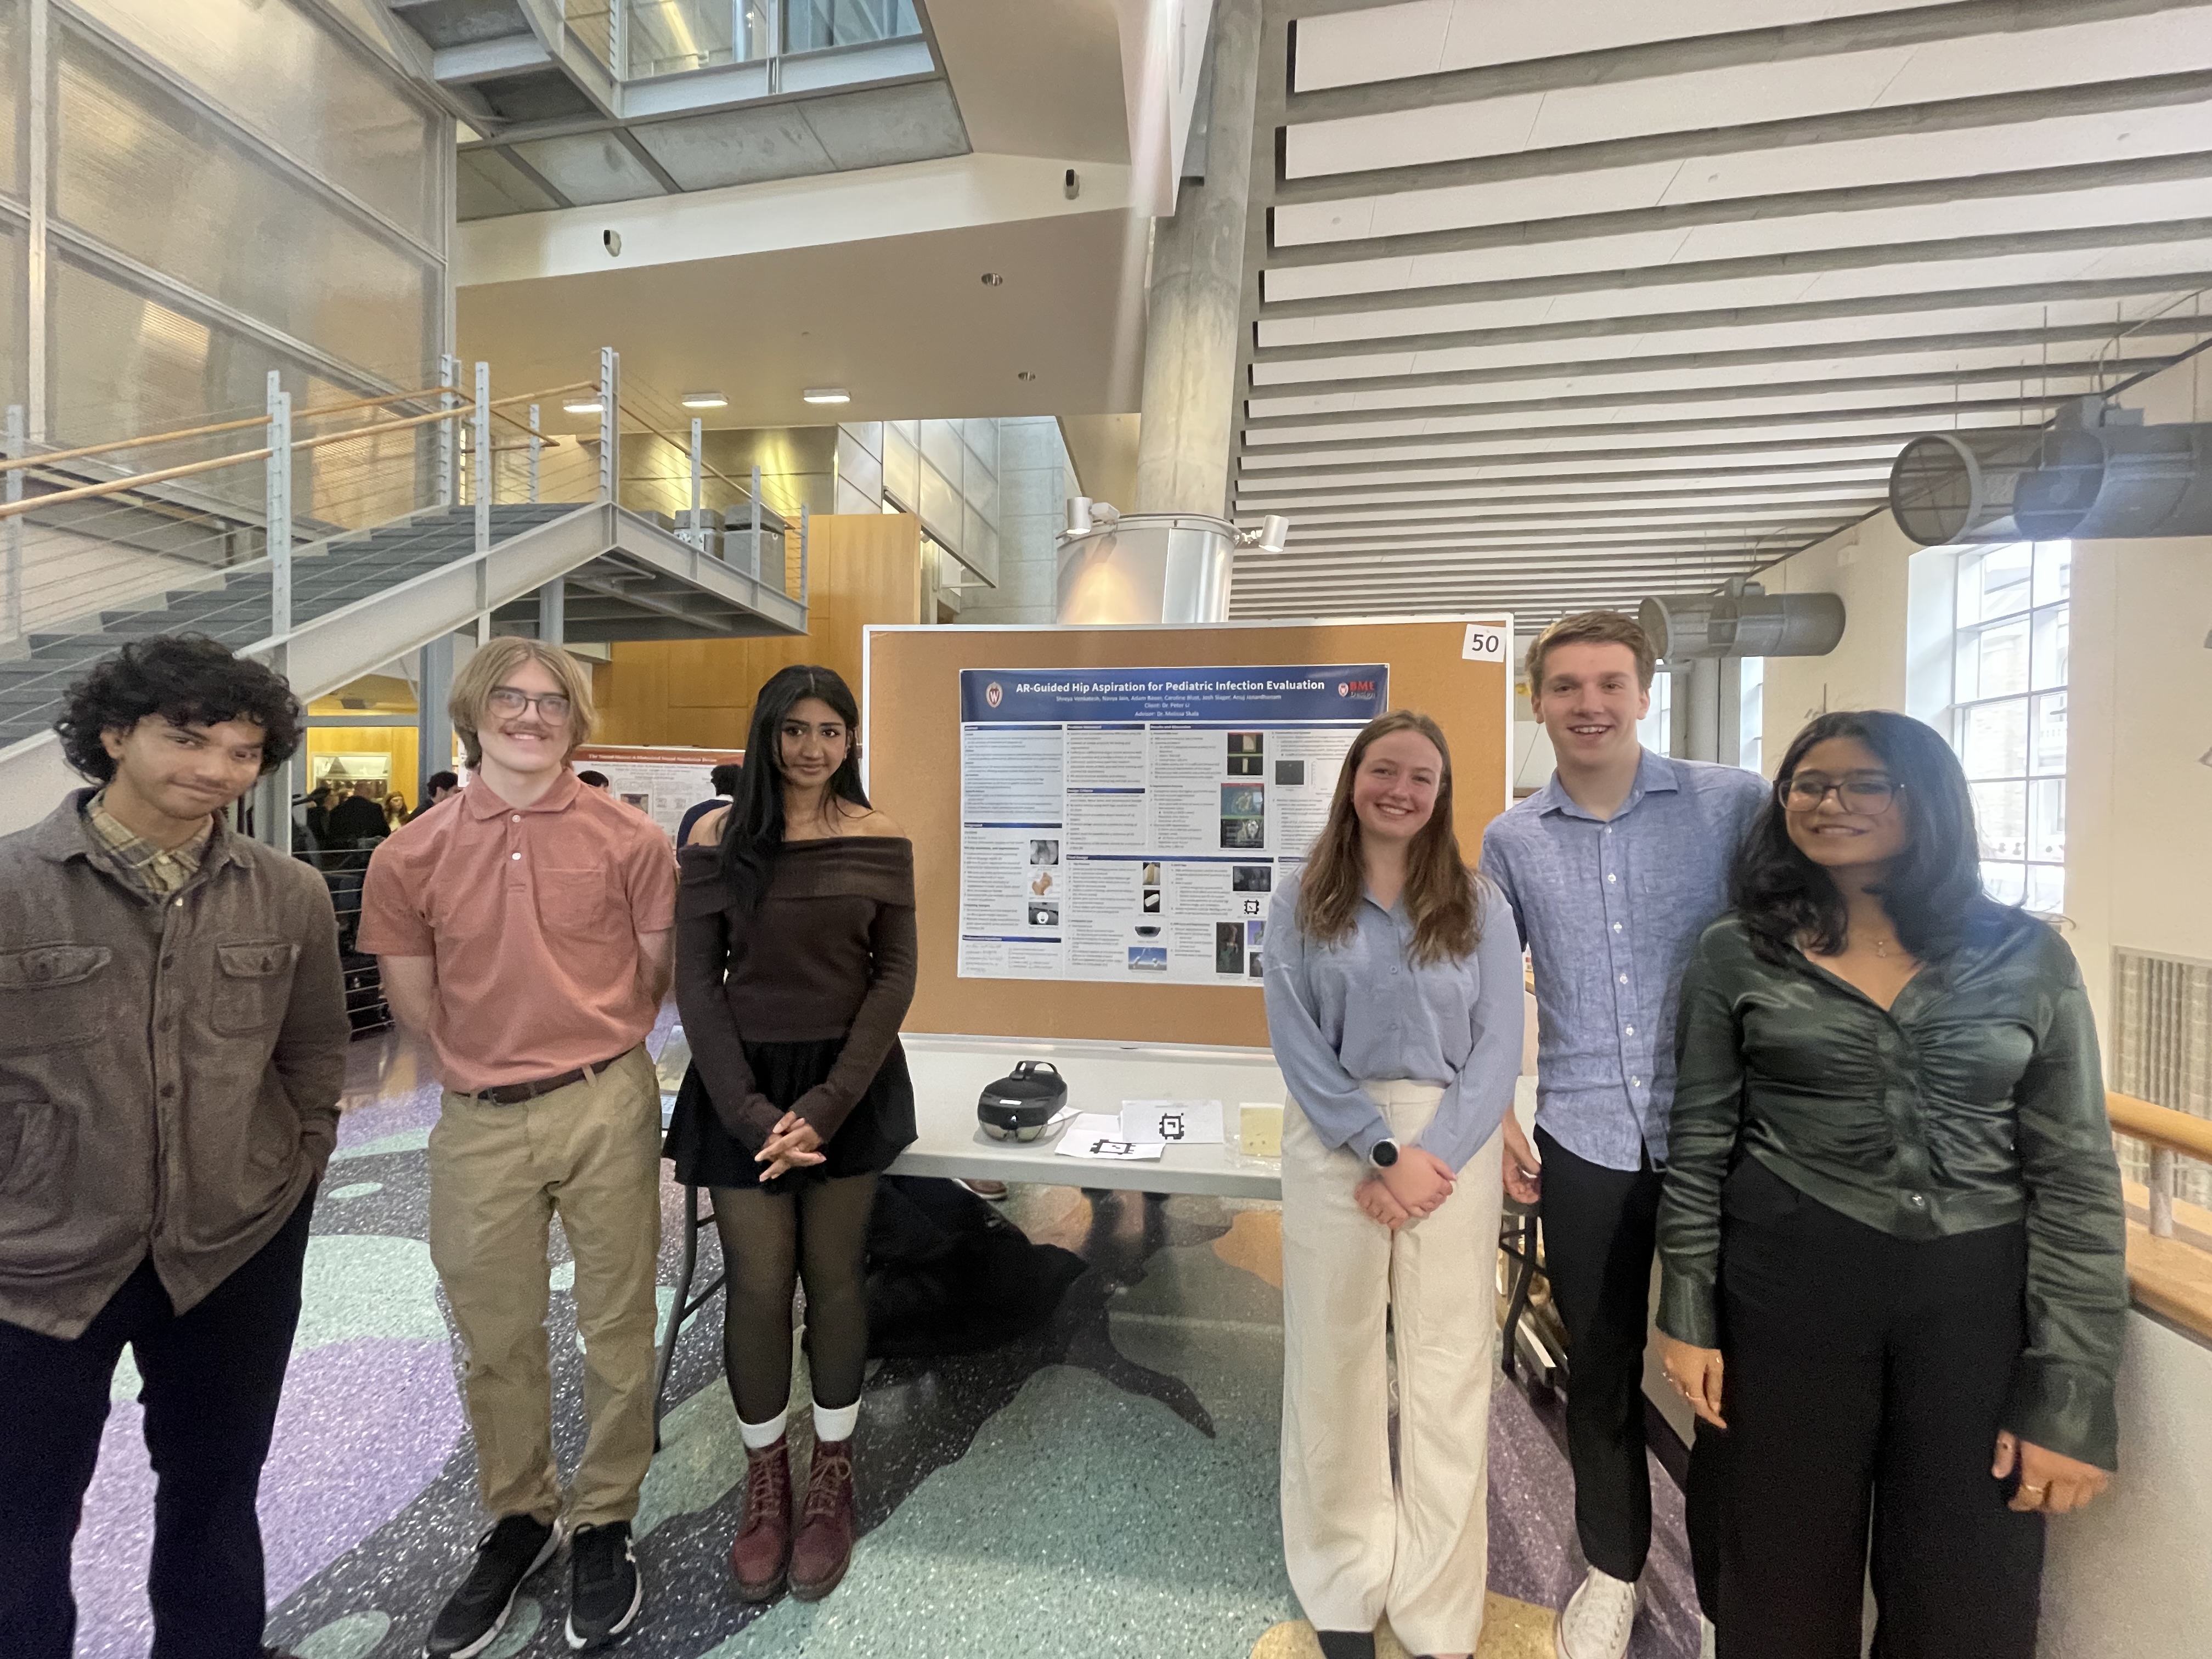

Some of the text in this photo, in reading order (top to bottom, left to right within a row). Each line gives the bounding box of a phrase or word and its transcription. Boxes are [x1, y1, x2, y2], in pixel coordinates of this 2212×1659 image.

[1472, 634, 1499, 652] 50
[1015, 680, 1325, 693] AR-Guided Hip Aspiration for Pediatric Infection Evaluation
